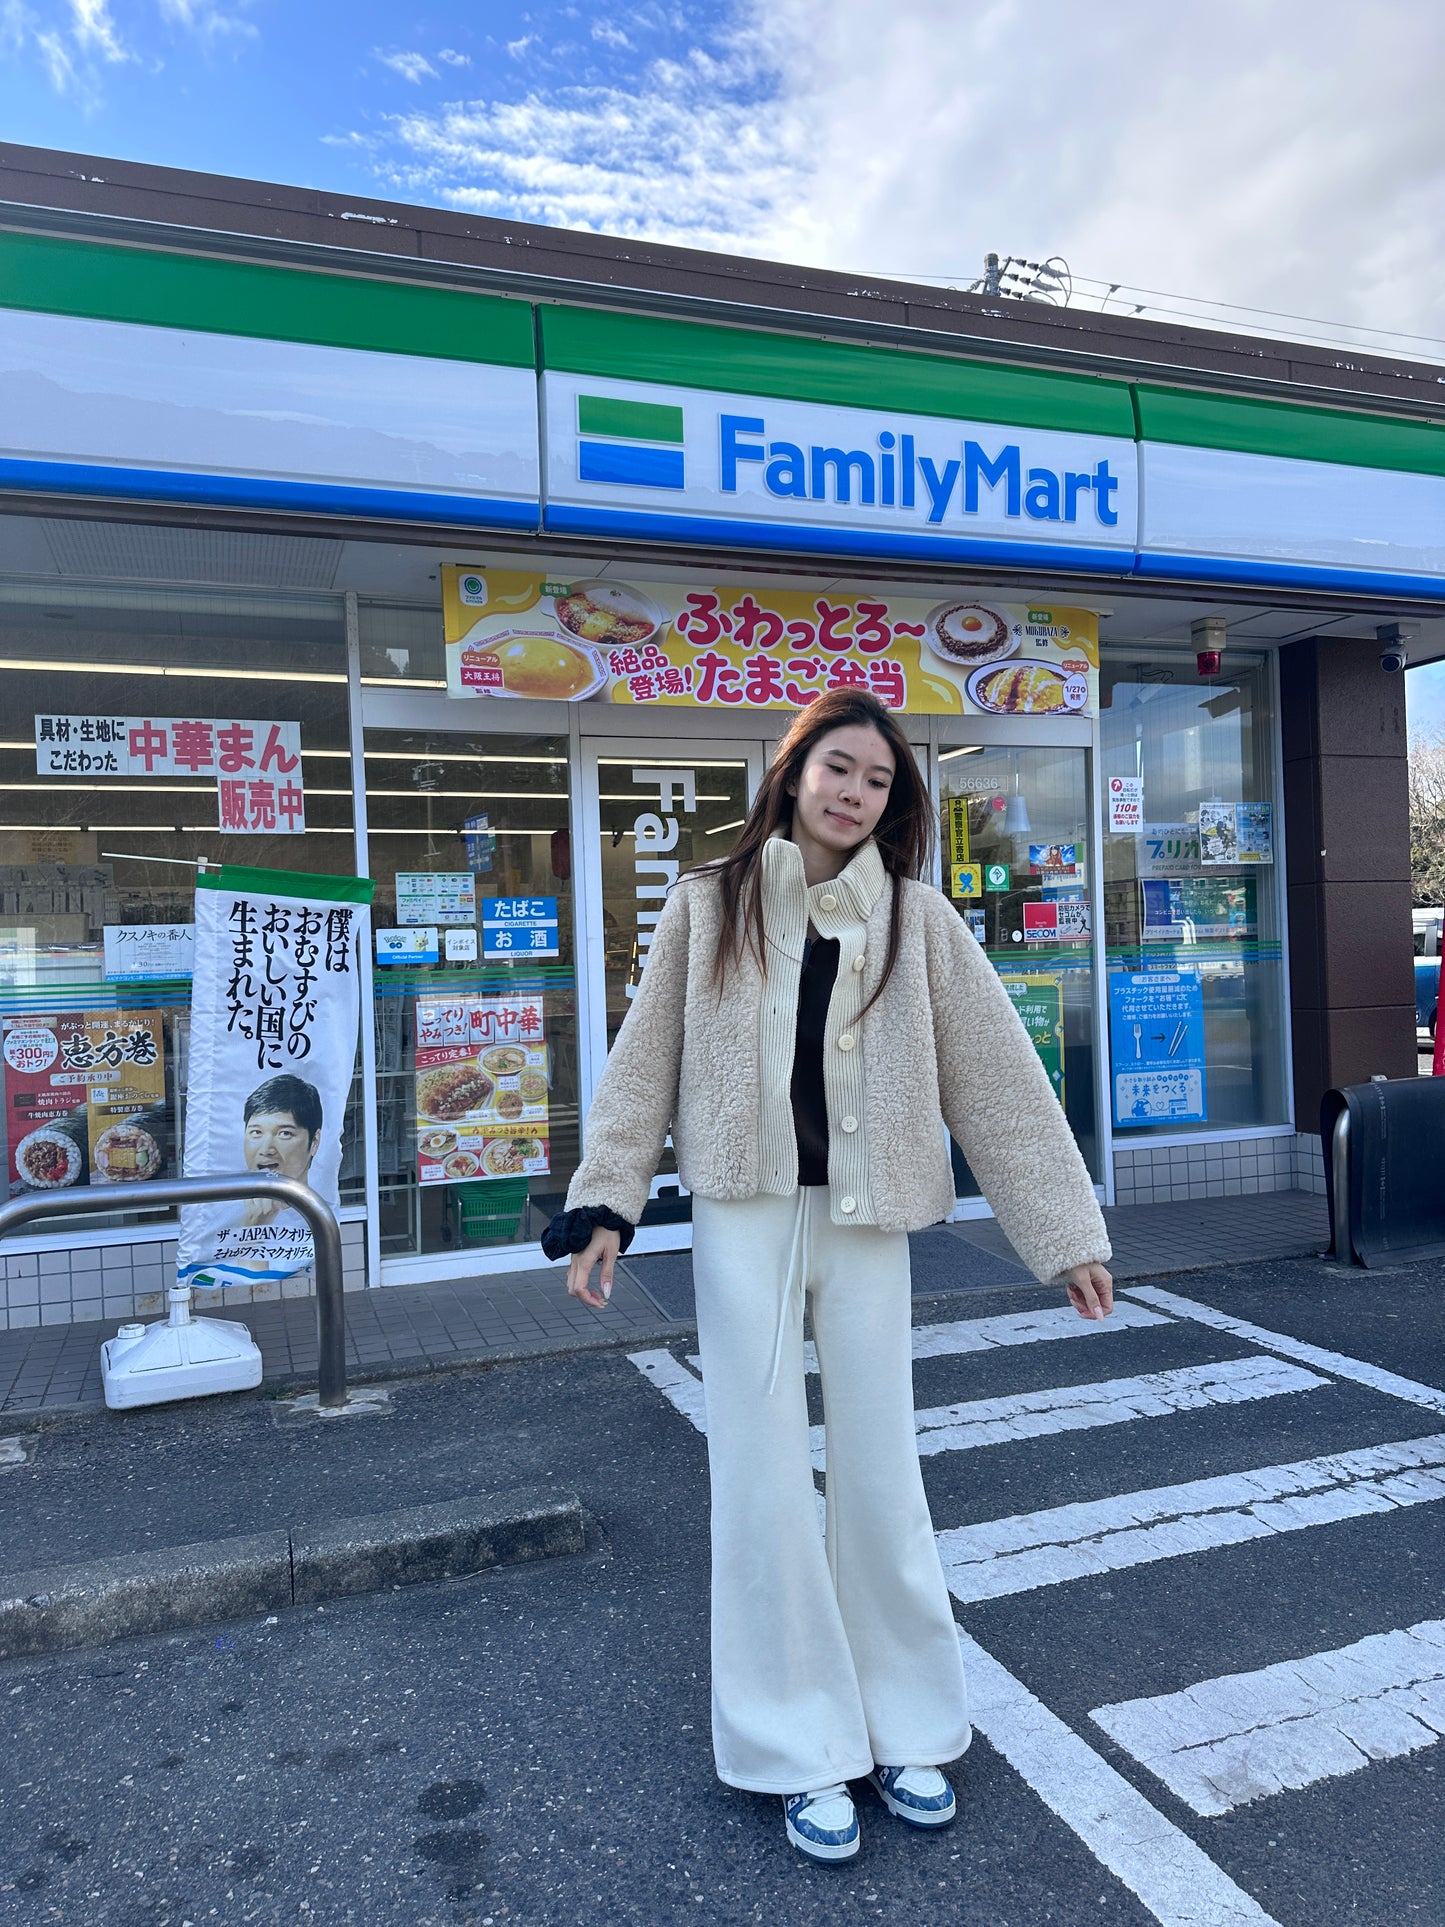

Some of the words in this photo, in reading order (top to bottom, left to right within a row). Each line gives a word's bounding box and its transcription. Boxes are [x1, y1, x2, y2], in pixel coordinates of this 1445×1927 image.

[720, 414, 1118, 526] FamilyMart
[677, 592, 926, 653] ふわっとろ〜
[463, 653, 498, 664] リニューアル
[608, 645, 669, 677] 絶品
[463, 671, 500, 683] 大阪王将
[628, 665, 693, 702] 登場!
[696, 652, 905, 709] たまご弁当
[40, 717, 126, 743] 具材・生地に
[128, 720, 300, 775] 中華まん
[50, 749, 118, 772] こだわった
[959, 777, 998, 790] 56636
[220, 779, 303, 831] 販売中
[495, 900, 546, 918] たばこ
[115, 928, 193, 944] クスノキの番人
[324, 908, 354, 973] 僕は
[495, 930, 548, 948] お酒
[1026, 929, 1057, 938] SECOM
[225, 900, 259, 1040] 生まれた。
[255, 903, 292, 1070] おいしい国に
[287, 906, 323, 1060] おむすびの
[421, 1007, 464, 1027] こってり
[469, 1005, 542, 1037] 町中華
[420, 1023, 468, 1042] やみつき!
[1032, 1031, 1052, 1044] っと
[61, 1030, 158, 1069] 恵方巻
[421, 1046, 472, 1064] こってり定番!
[16, 1058, 48, 1069] おトク!
[58, 1072, 113, 1084] ご予約承り中
[1132, 1082, 1186, 1097] 未来をつくる
[217, 1226, 313, 1243] ザ・JAPANクオリテ
